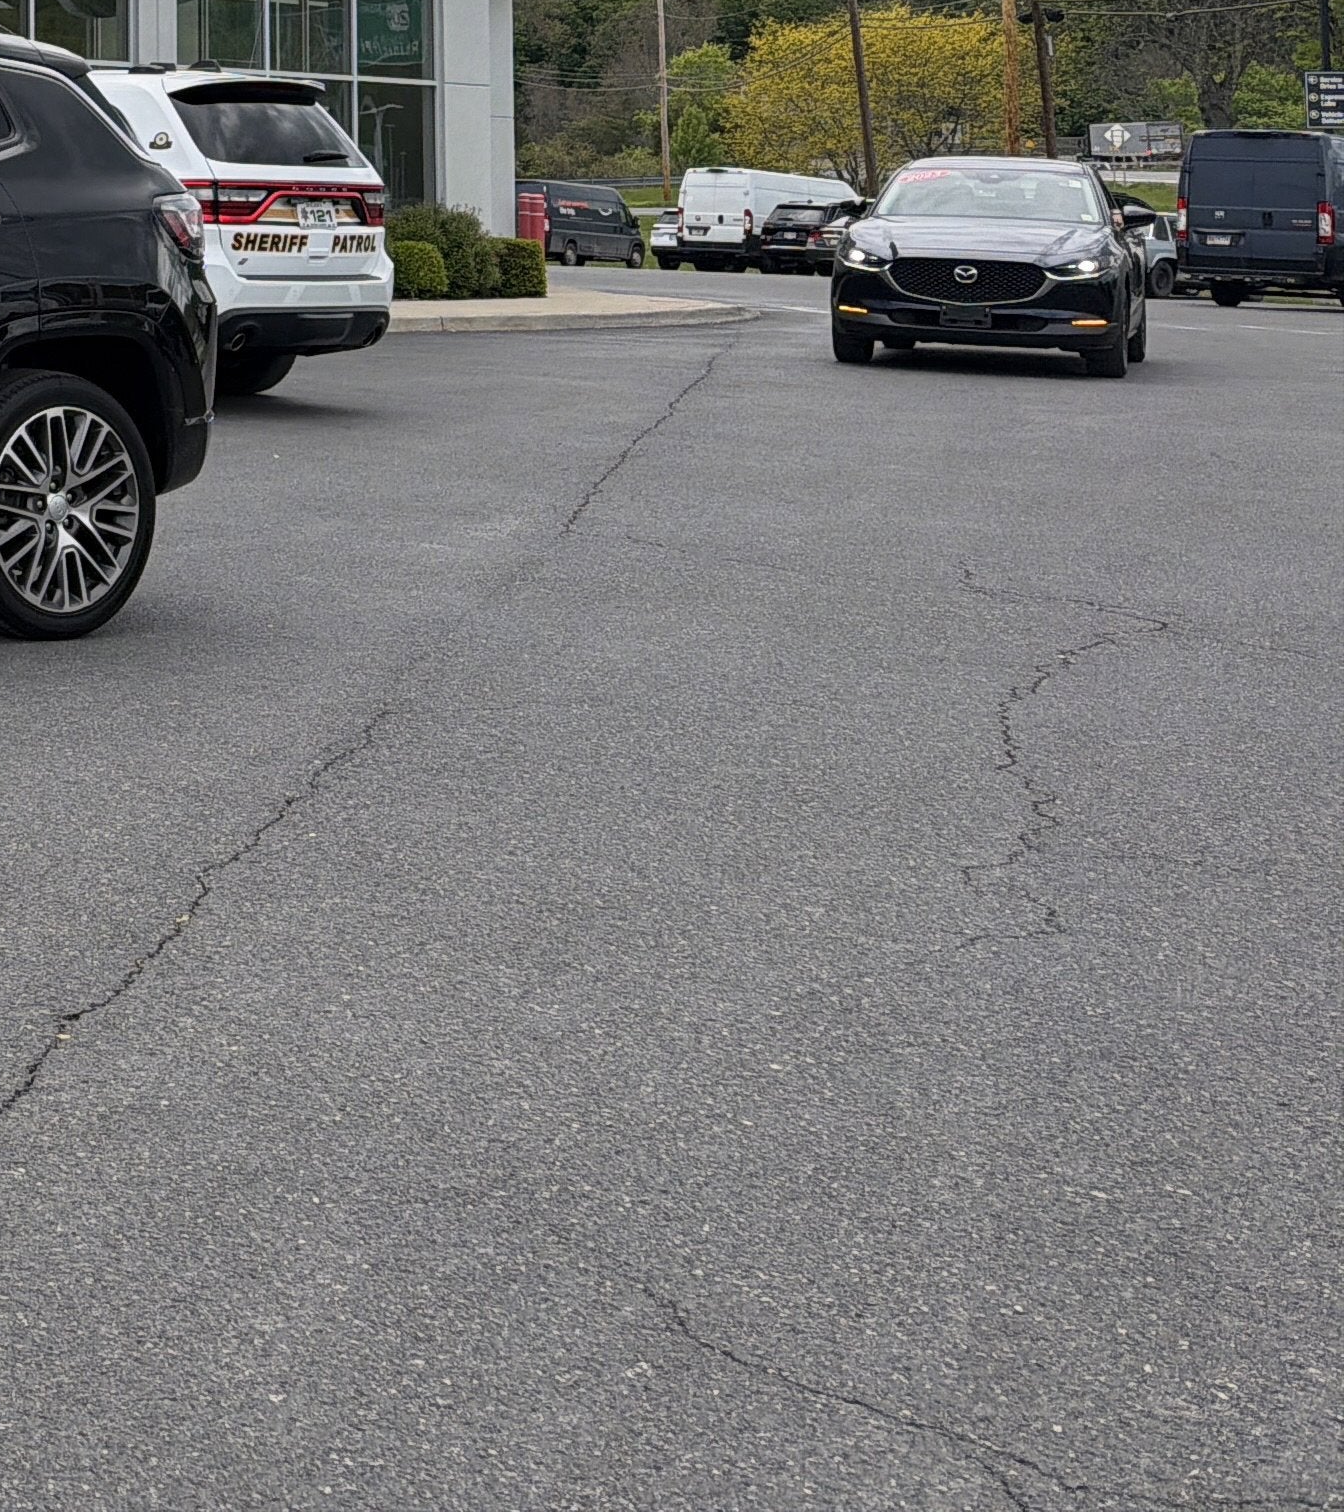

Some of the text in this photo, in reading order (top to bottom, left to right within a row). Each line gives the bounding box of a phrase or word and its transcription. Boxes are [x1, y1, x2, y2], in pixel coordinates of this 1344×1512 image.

[310, 209, 333, 222] 121
[231, 232, 377, 254] SHERIFF PATROL
